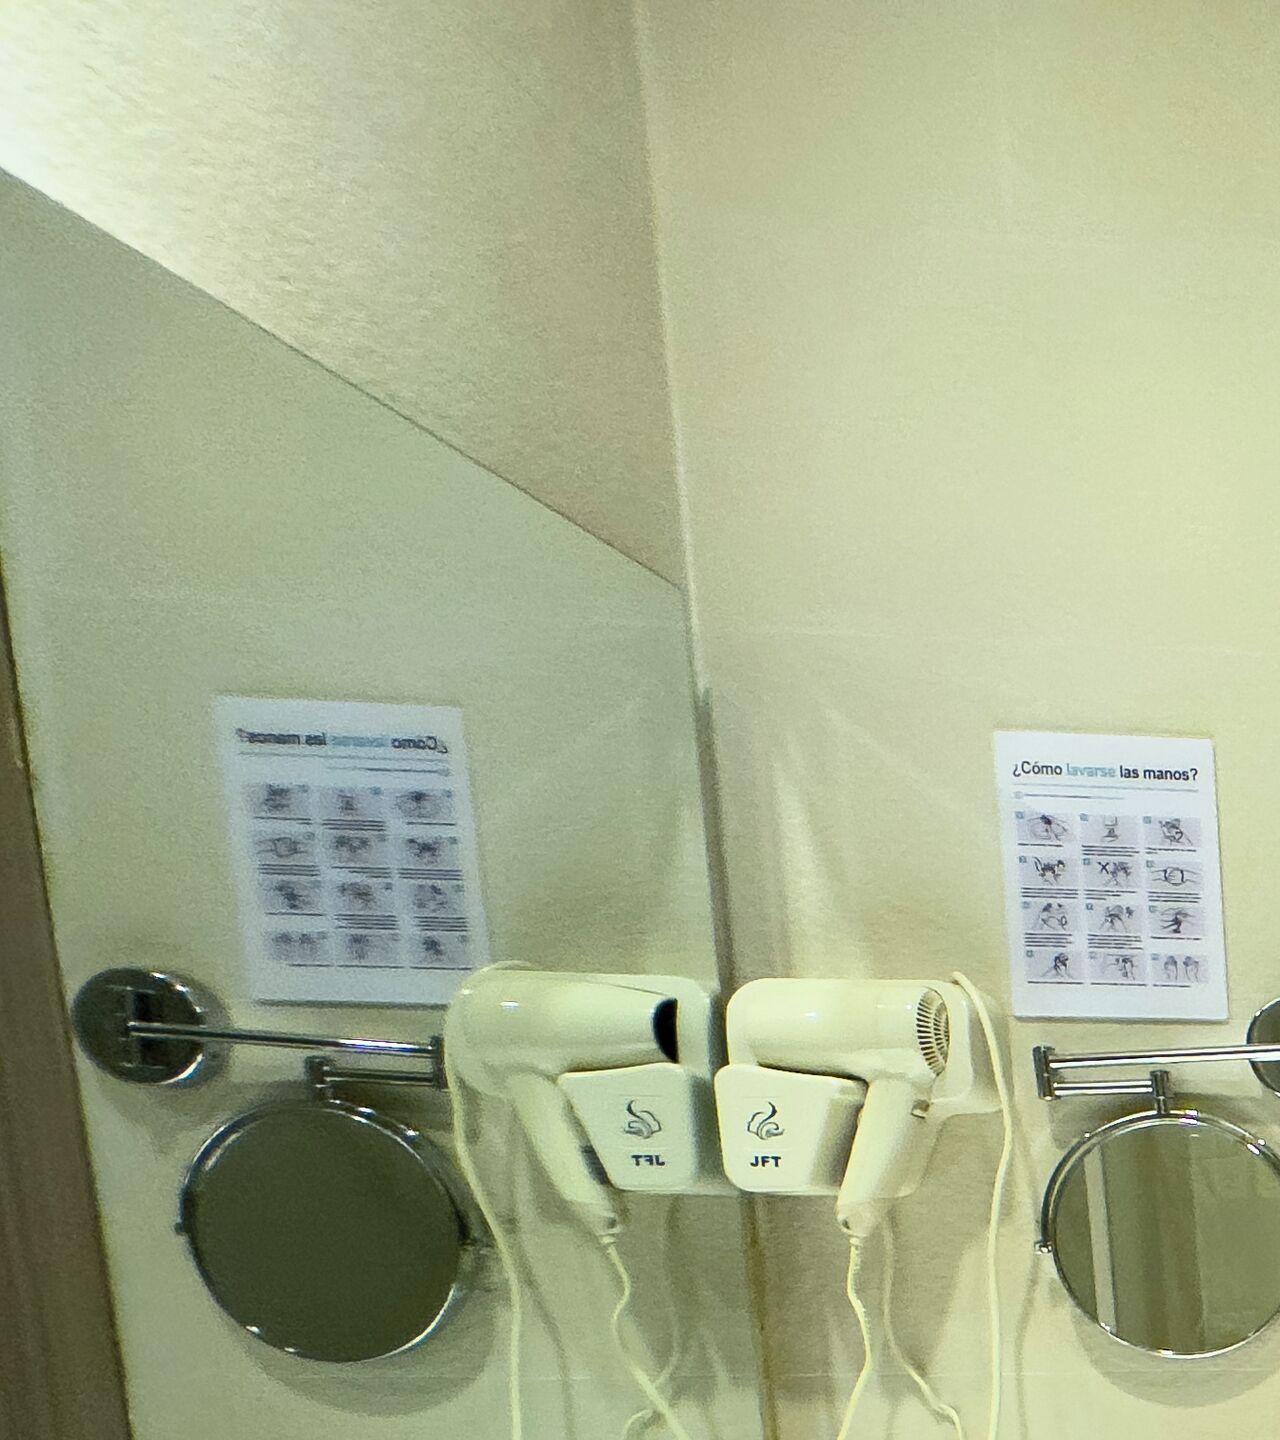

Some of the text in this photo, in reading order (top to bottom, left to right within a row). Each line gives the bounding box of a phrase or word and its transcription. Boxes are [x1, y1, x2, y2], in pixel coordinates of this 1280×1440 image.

[1012, 760, 1198, 781] ¿Cómo lavarse las manos?
[750, 1155, 782, 1168] JFT
